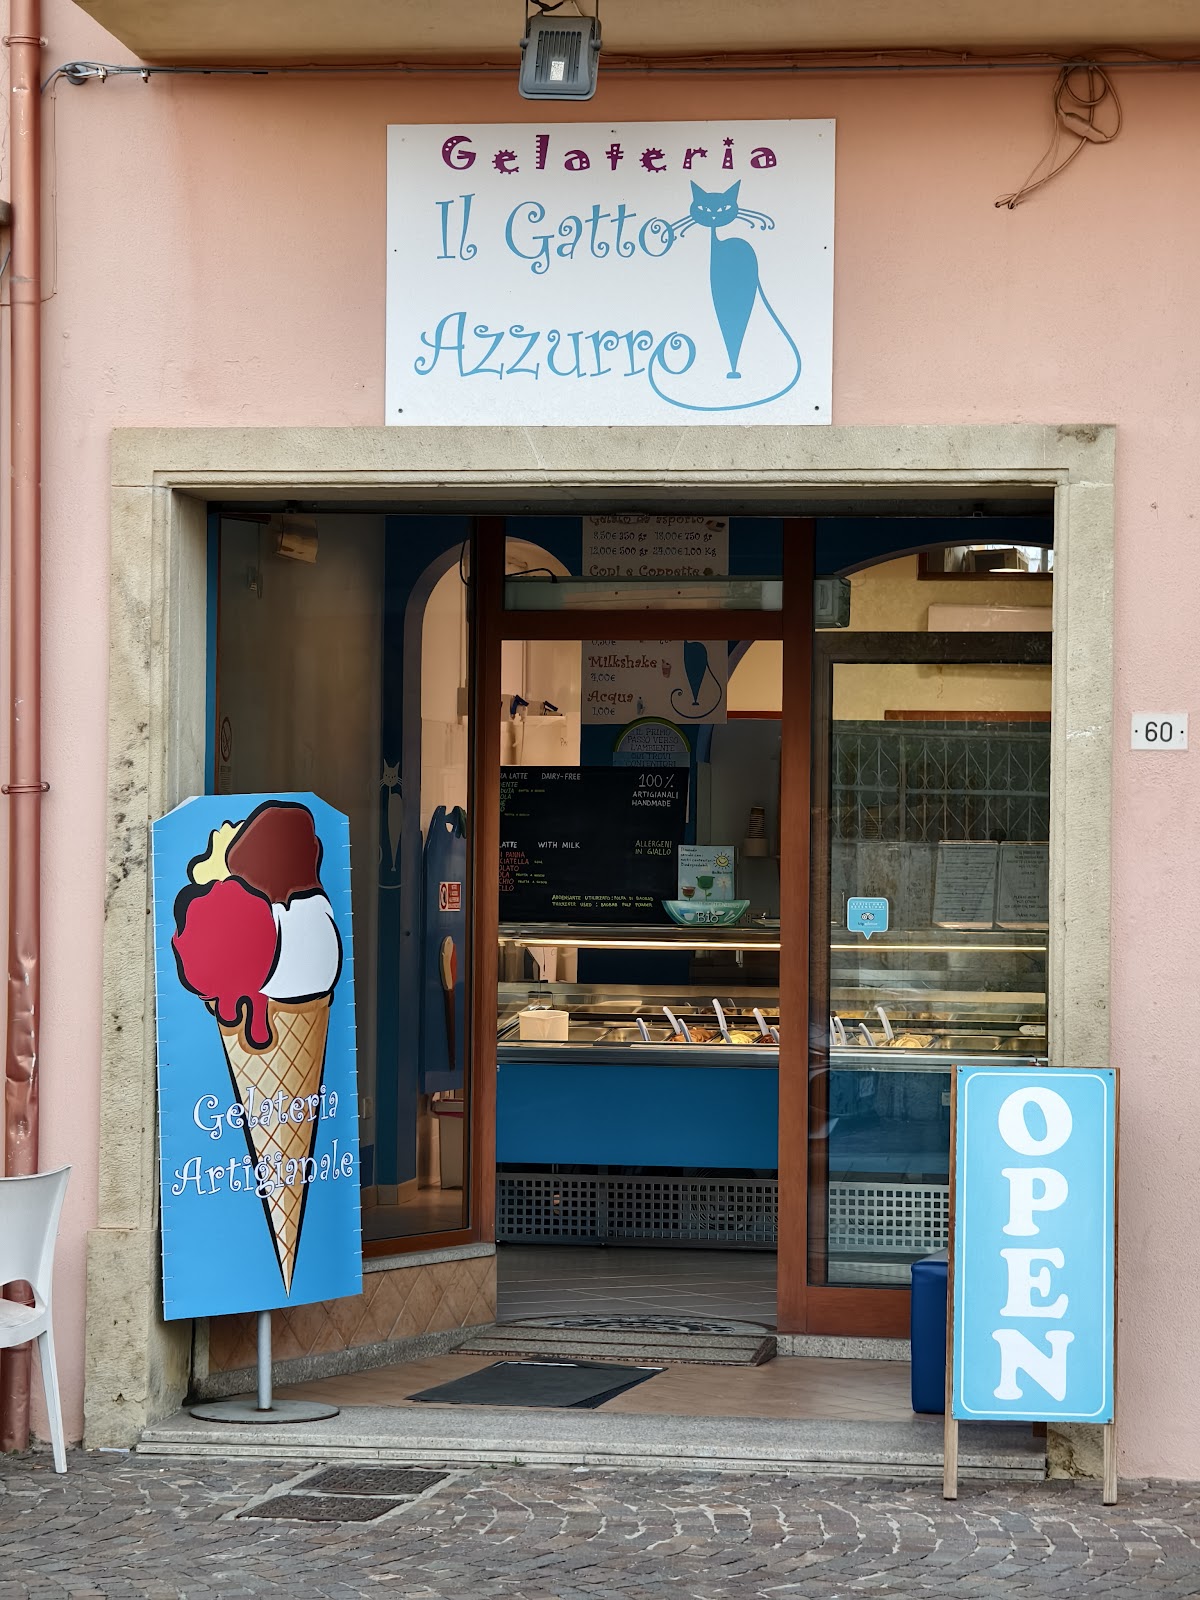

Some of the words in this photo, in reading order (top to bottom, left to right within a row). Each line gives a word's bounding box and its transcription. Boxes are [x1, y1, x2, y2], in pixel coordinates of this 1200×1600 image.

[441, 134, 777, 175] Gelateria
[435, 193, 478, 261] Il
[505, 201, 675, 275] Gatto
[414, 312, 696, 380] Azzurro
[619, 531, 635, 540] 350
[685, 531, 700, 541] 750
[703, 532, 713, 542] gr
[619, 546, 636, 555] 500
[639, 564, 700, 577] Coppette
[587, 654, 657, 668] Milkshake
[587, 690, 633, 705] Acqua
[646, 728, 671, 736] PRIMO
[1145, 721, 1173, 743] 60
[627, 736, 650, 744] PASSO
[653, 736, 679, 744] VERSO
[509, 772, 528, 780] LATTE
[541, 772, 582, 781] DAIRY-FREE
[632, 790, 679, 799] ARTIGIANALI
[631, 799, 672, 807] HANDMADE
[537, 841, 558, 849] WITH
[561, 841, 581, 849] MILK
[635, 839, 672, 848] ALLERGENI
[646, 848, 672, 856] GIALLO
[695, 910, 719, 923] Bio
[193, 1084, 338, 1140] Gelateria
[171, 1138, 354, 1199] Artigianale
[991, 1086, 1075, 1402] OPEN
